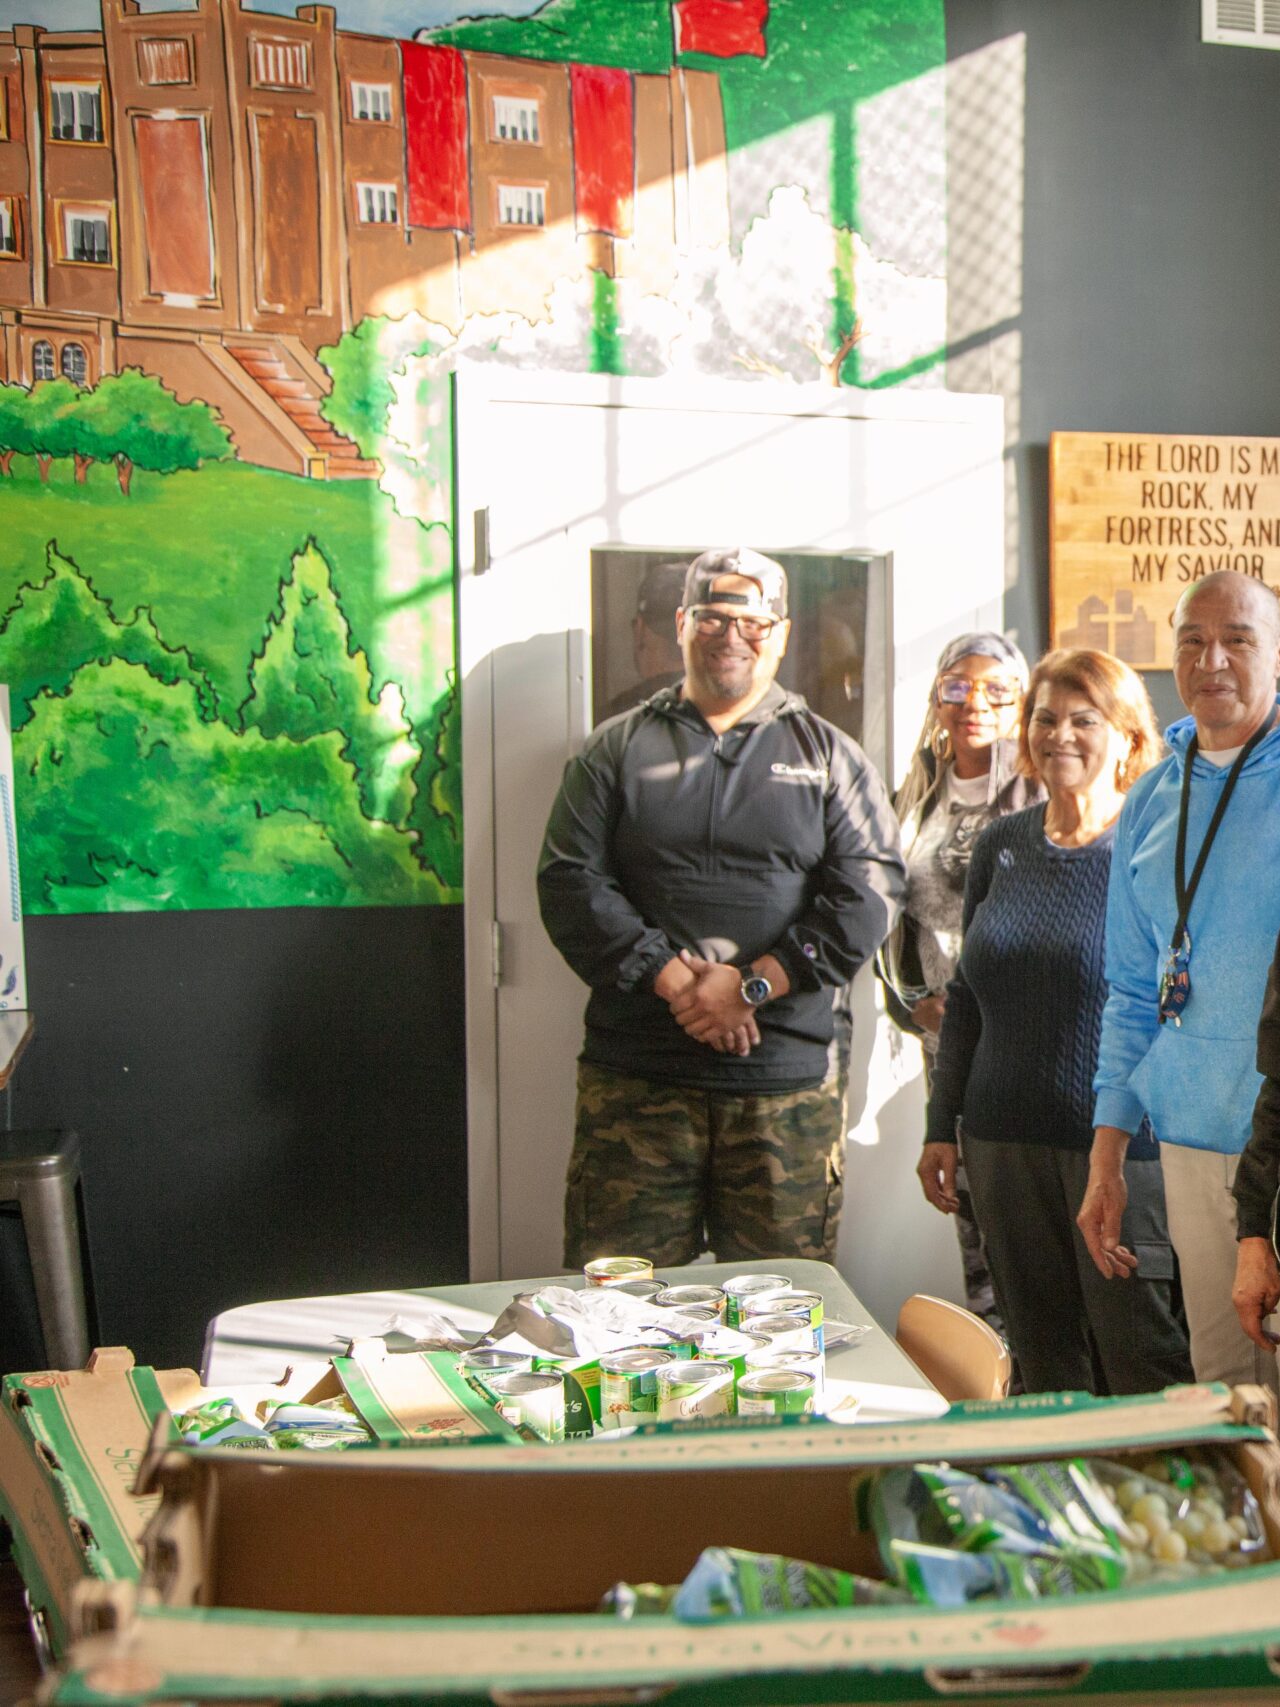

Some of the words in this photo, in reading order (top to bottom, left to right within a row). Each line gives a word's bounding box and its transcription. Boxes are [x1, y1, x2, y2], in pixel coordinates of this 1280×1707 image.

[1103, 442, 1145, 472] THE
[1157, 444, 1220, 474] LORD
[1230, 446, 1251, 475] IS
[1222, 483, 1258, 511] MY
[1105, 516, 1233, 550] FORTRESS,
[1132, 554, 1168, 583] MY
[1177, 554, 1265, 583] SAVIOR
